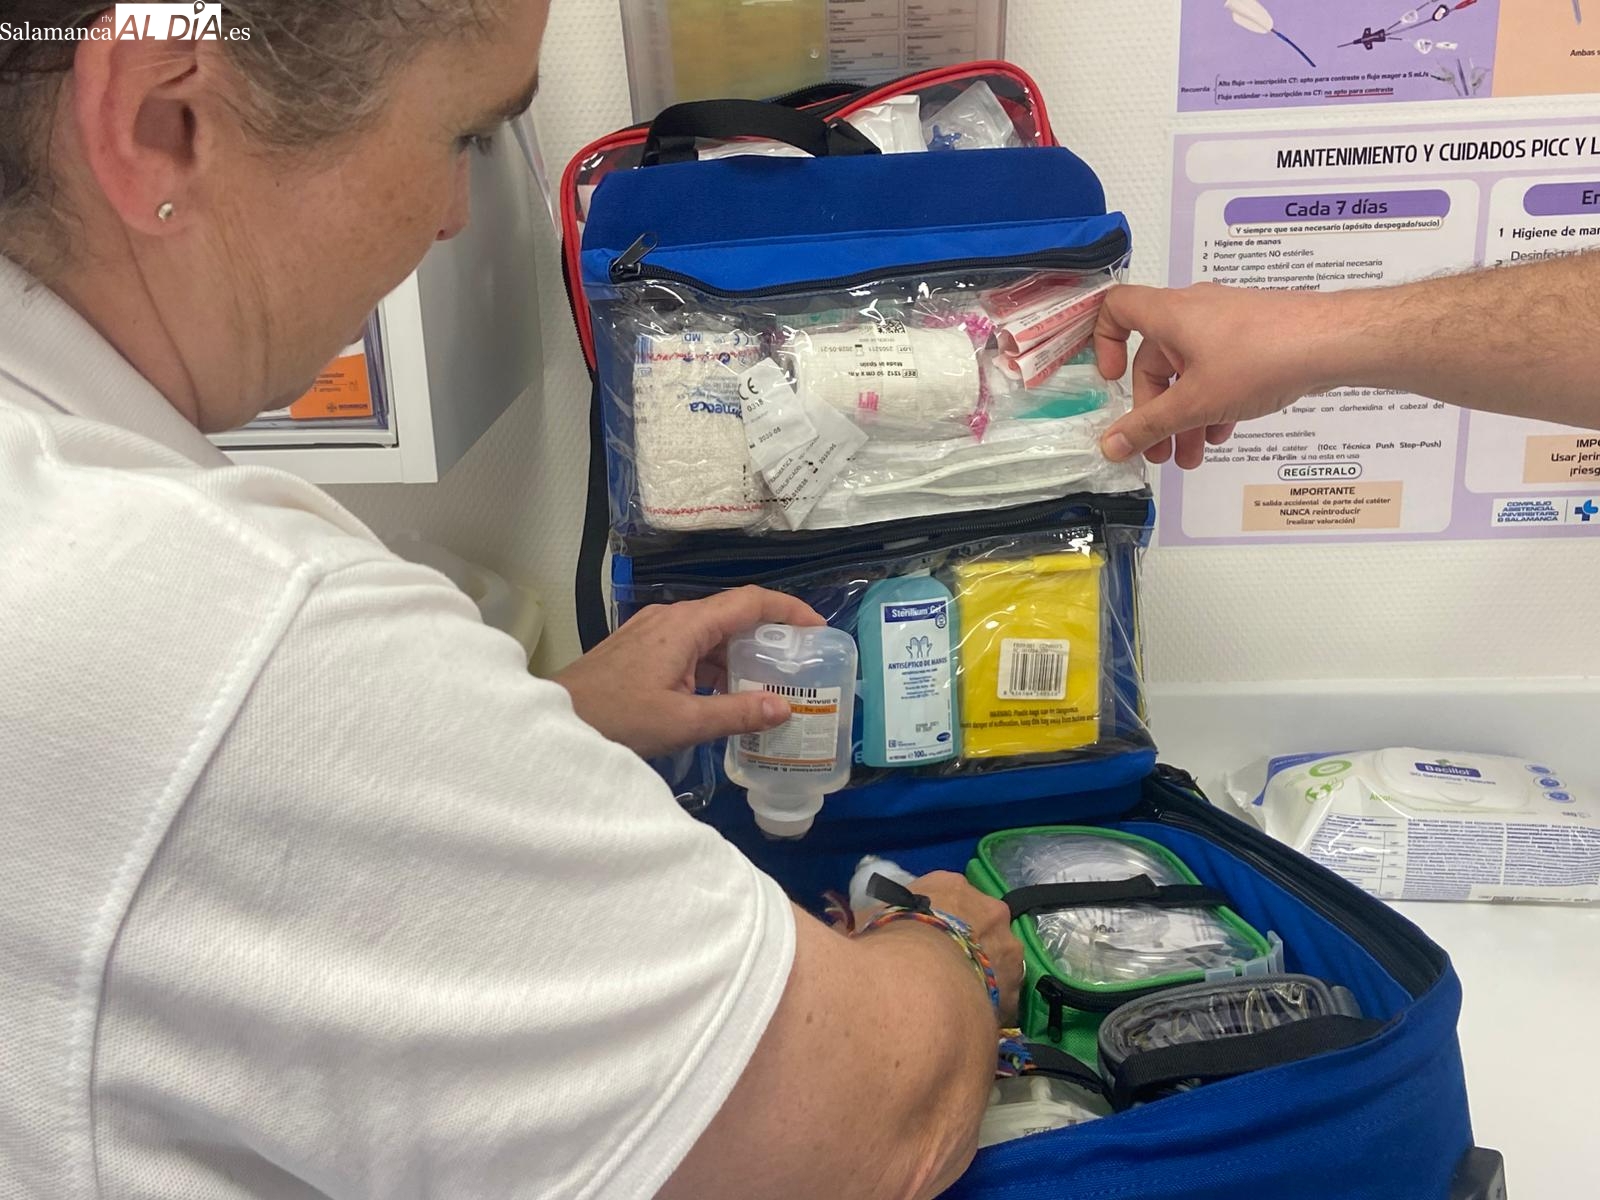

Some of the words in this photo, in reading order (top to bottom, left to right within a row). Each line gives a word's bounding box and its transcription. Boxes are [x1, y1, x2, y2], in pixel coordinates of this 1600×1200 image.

[1570, 49, 1595, 57] Ambas
[1232, 79, 1245, 87] flujo
[1254, 78, 1287, 86] inscripción
[1300, 77, 1313, 85] apto
[1367, 73, 1380, 81] flujo
[1233, 91, 1260, 99] estándar
[1269, 89, 1302, 98] inscripción
[1277, 145, 1417, 168] MANTENIMIENTO
[1424, 144, 1434, 162] Y
[1439, 140, 1526, 161] CUIDADOS
[1532, 138, 1569, 158] PICC
[1575, 137, 1586, 155] Y
[1285, 201, 1330, 217] Cada
[1336, 200, 1346, 215] 7
[1351, 198, 1388, 214] días
[1243, 226, 1272, 235] siempre
[1274, 226, 1288, 234] que
[1304, 223, 1341, 232] necesario
[1342, 223, 1372, 232] (apósito
[1374, 219, 1440, 230] despegado/sucio)
[1499, 227, 1503, 237] 1
[1512, 227, 1557, 240] Higiene
[1561, 226, 1576, 237] de
[1214, 239, 1243, 248] Higiene
[1238, 252, 1267, 260] guantes
[1268, 250, 1281, 258] NO
[1282, 249, 1314, 257] estériles
[1213, 264, 1239, 272] Montar
[1241, 264, 1265, 272] campo
[1267, 262, 1289, 270] estéril
[1315, 260, 1344, 268] material
[1346, 259, 1383, 268] necesario
[1239, 275, 1265, 284] apósito
[1267, 274, 1315, 284] transparente
[1316, 273, 1345, 281] (técnica
[1347, 271, 1383, 280] streching)
[1292, 406, 1316, 414] limpiar
[1339, 404, 1383, 412] clorhexidina
[1233, 431, 1284, 439] bioconectores
[1285, 430, 1316, 438] estériles
[1205, 446, 1234, 454] Realizar
[1282, 444, 1308, 452] catéter
[1342, 442, 1371, 450] Técnica
[1551, 453, 1577, 462] Usar
[1283, 466, 1356, 477] REGÍSTRALO
[1290, 486, 1356, 496] IMPORTANTE
[1366, 497, 1391, 505] catéter
[1280, 508, 1310, 516] NUNCA
[1312, 507, 1361, 516] reintroducir
[1286, 518, 1315, 526] (realizar
[1317, 517, 1356, 525] valoración)
[892, 608, 927, 618] Sterillium
[888, 660, 923, 669] ANTISÉPTICO
[931, 657, 947, 665] MANOS
[1425, 764, 1471, 776] Bacillol
